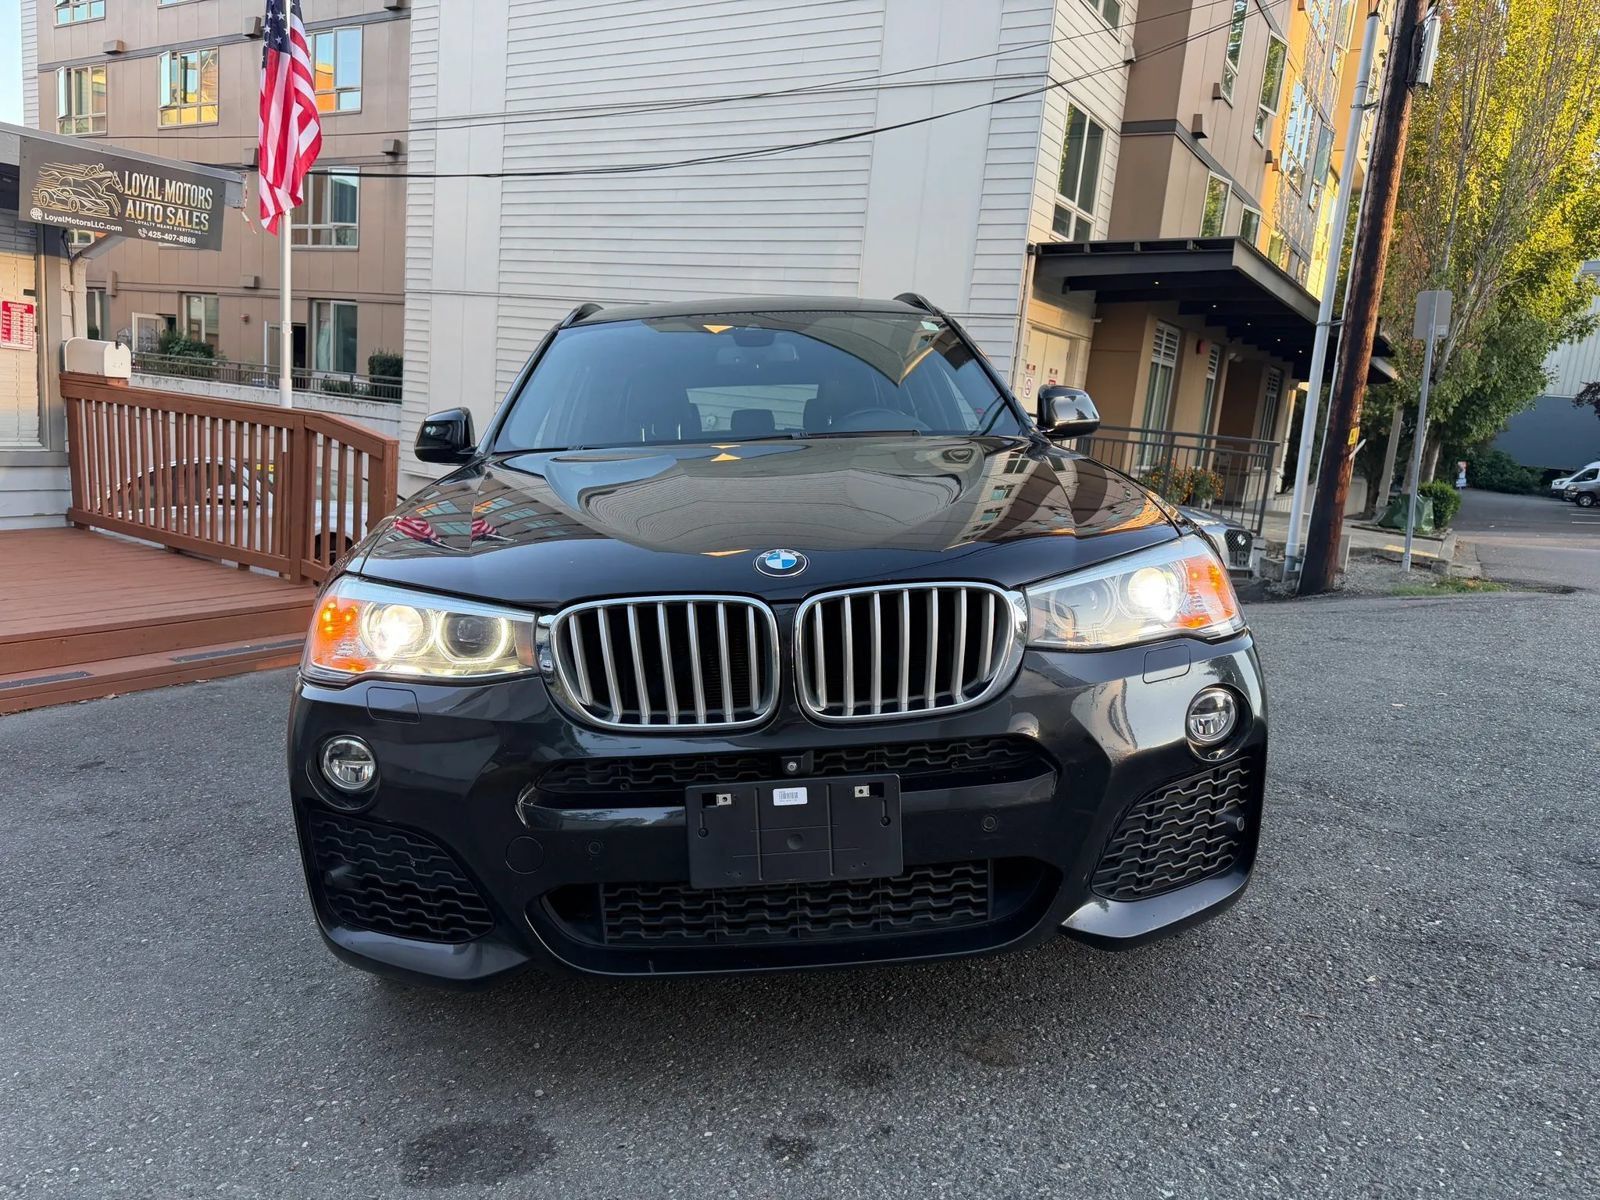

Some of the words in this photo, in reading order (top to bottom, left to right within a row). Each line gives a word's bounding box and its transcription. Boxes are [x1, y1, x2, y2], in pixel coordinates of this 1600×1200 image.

[124, 170, 162, 201] LOYAL
[164, 178, 213, 210] MOTORS
[44, 212, 123, 232] LoyalMotorsLLC.com
[125, 199, 163, 223] AUTO
[166, 206, 209, 231] SALES
[134, 219, 155, 227] LOYALTY
[147, 230, 196, 245] 425-407-8888
